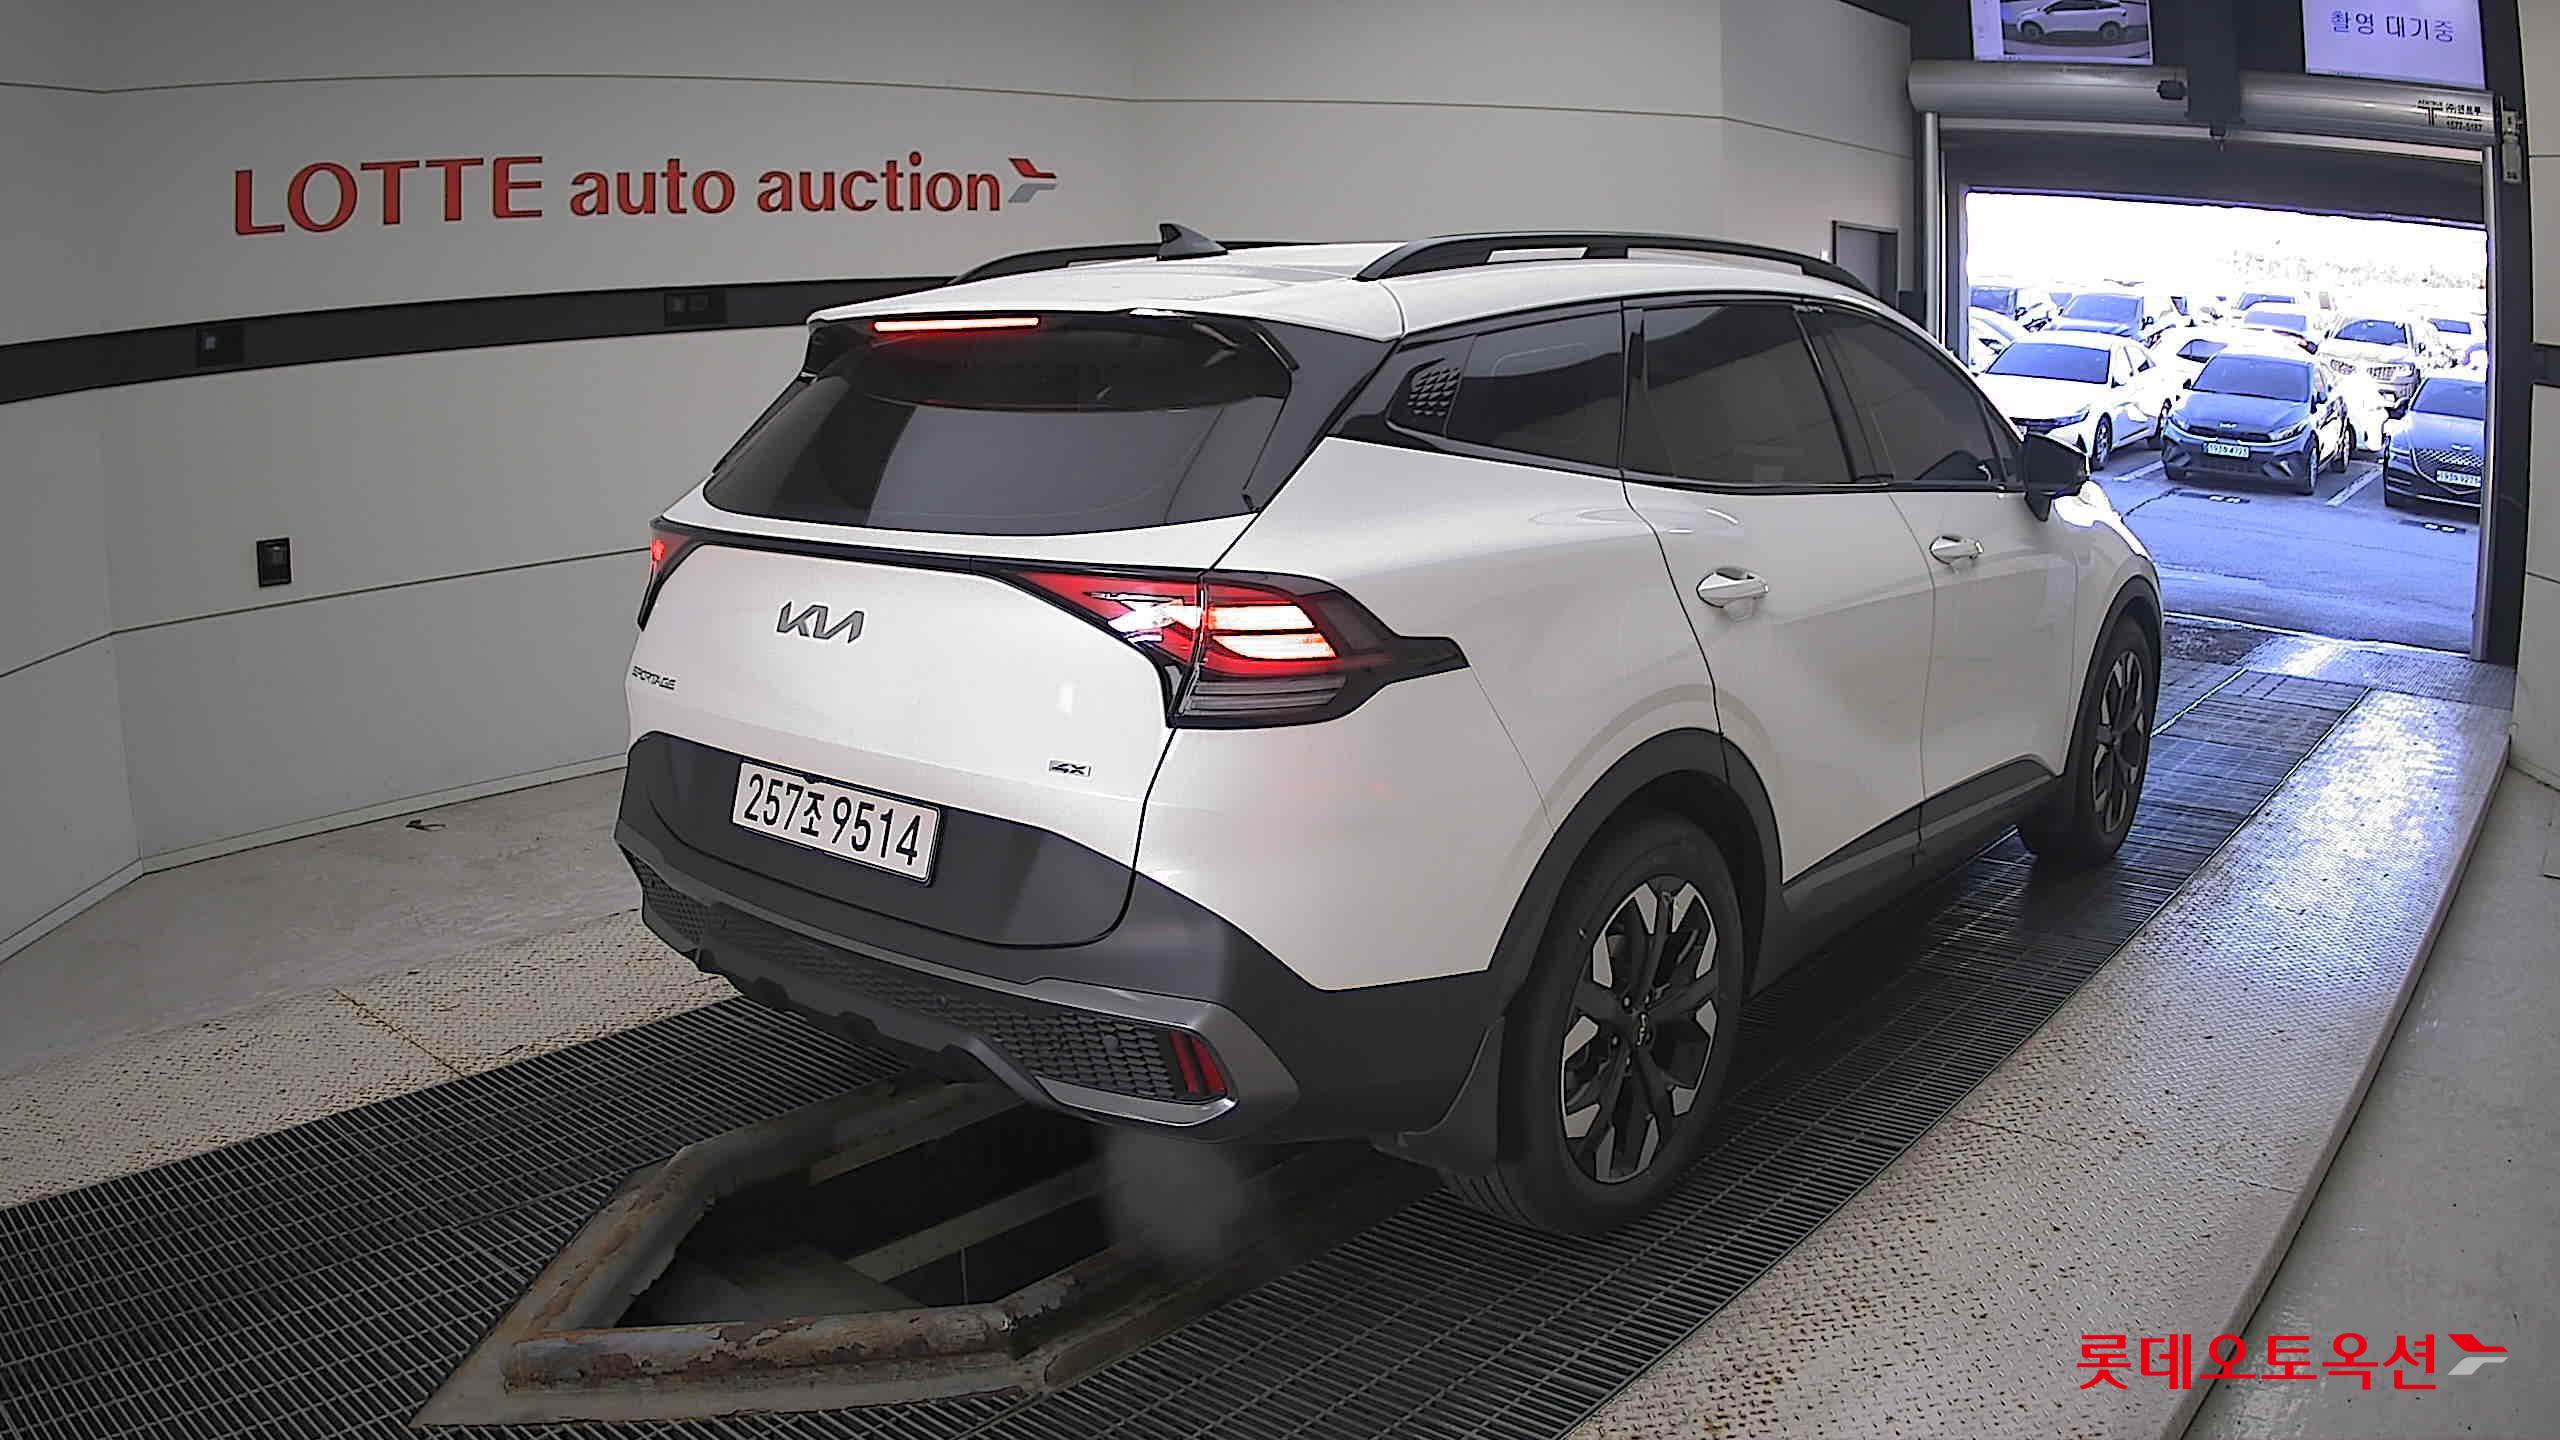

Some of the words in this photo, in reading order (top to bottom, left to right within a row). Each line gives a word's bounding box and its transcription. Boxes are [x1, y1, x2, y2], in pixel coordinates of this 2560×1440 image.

[2331, 10, 2375, 36] 촬영
[2385, 15, 2454, 43] 대기중
[235, 156, 541, 236] LOTTE
[570, 160, 736, 216] auto
[758, 152, 1001, 212] auction
[777, 600, 865, 643] KIA
[631, 664, 676, 691] SPORTAGE
